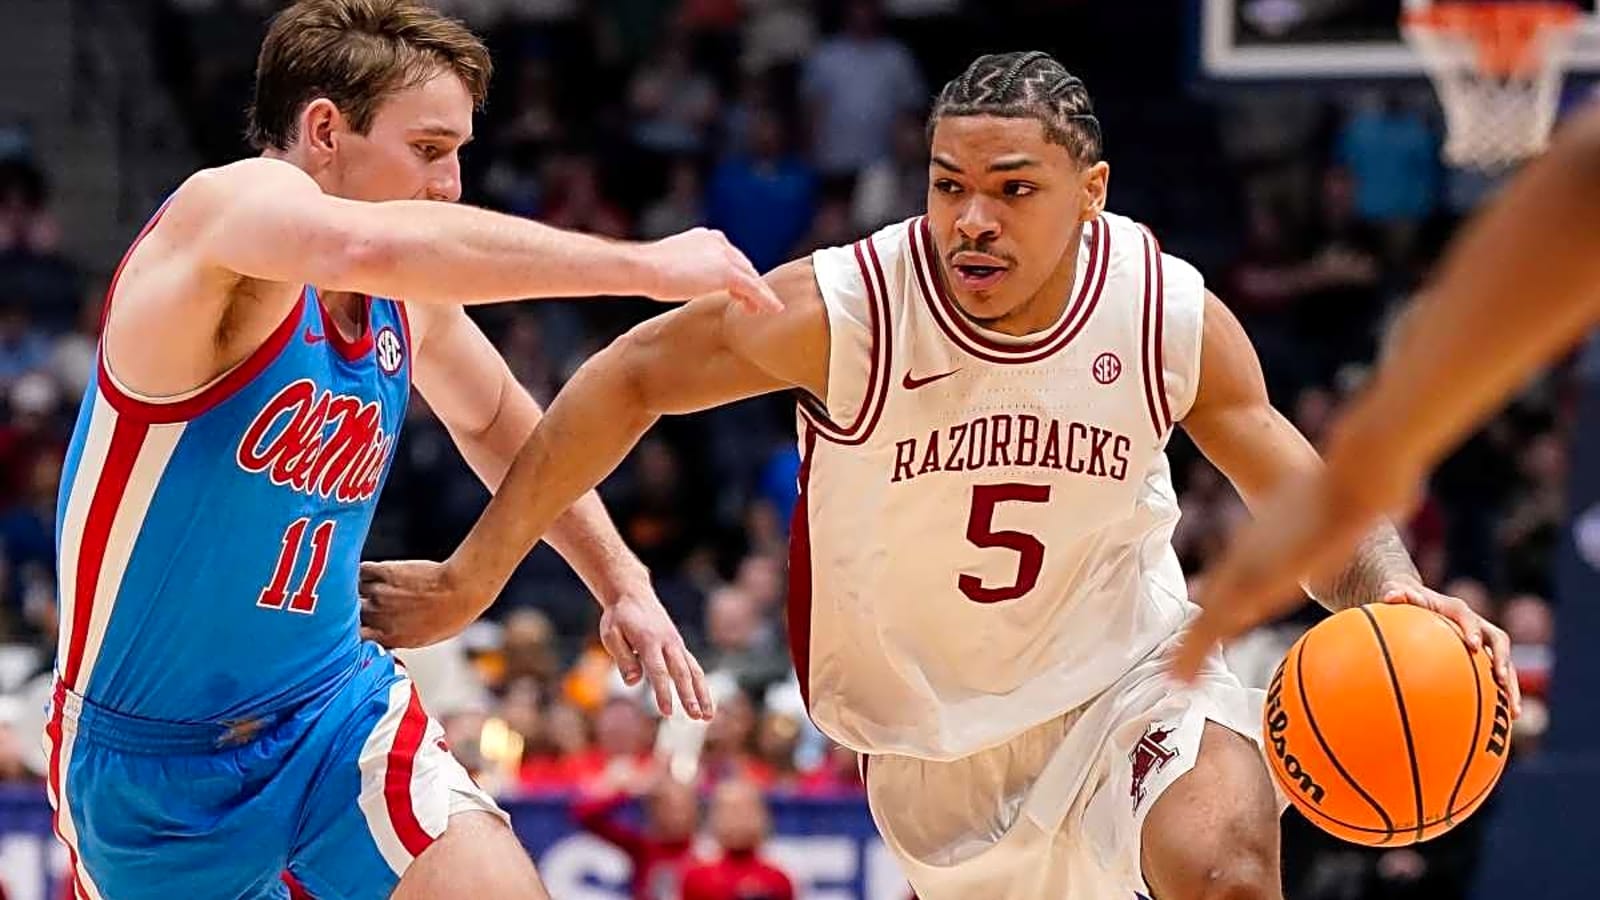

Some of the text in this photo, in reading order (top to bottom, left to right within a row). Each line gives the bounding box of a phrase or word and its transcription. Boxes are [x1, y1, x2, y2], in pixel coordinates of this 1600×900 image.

[377, 330, 402, 371] SEC
[1095, 356, 1120, 382] SEC
[236, 378, 331, 492] Ole
[891, 414, 1131, 482] RAZORBACKS
[256, 517, 336, 614] 11
[958, 482, 1051, 604] 5
